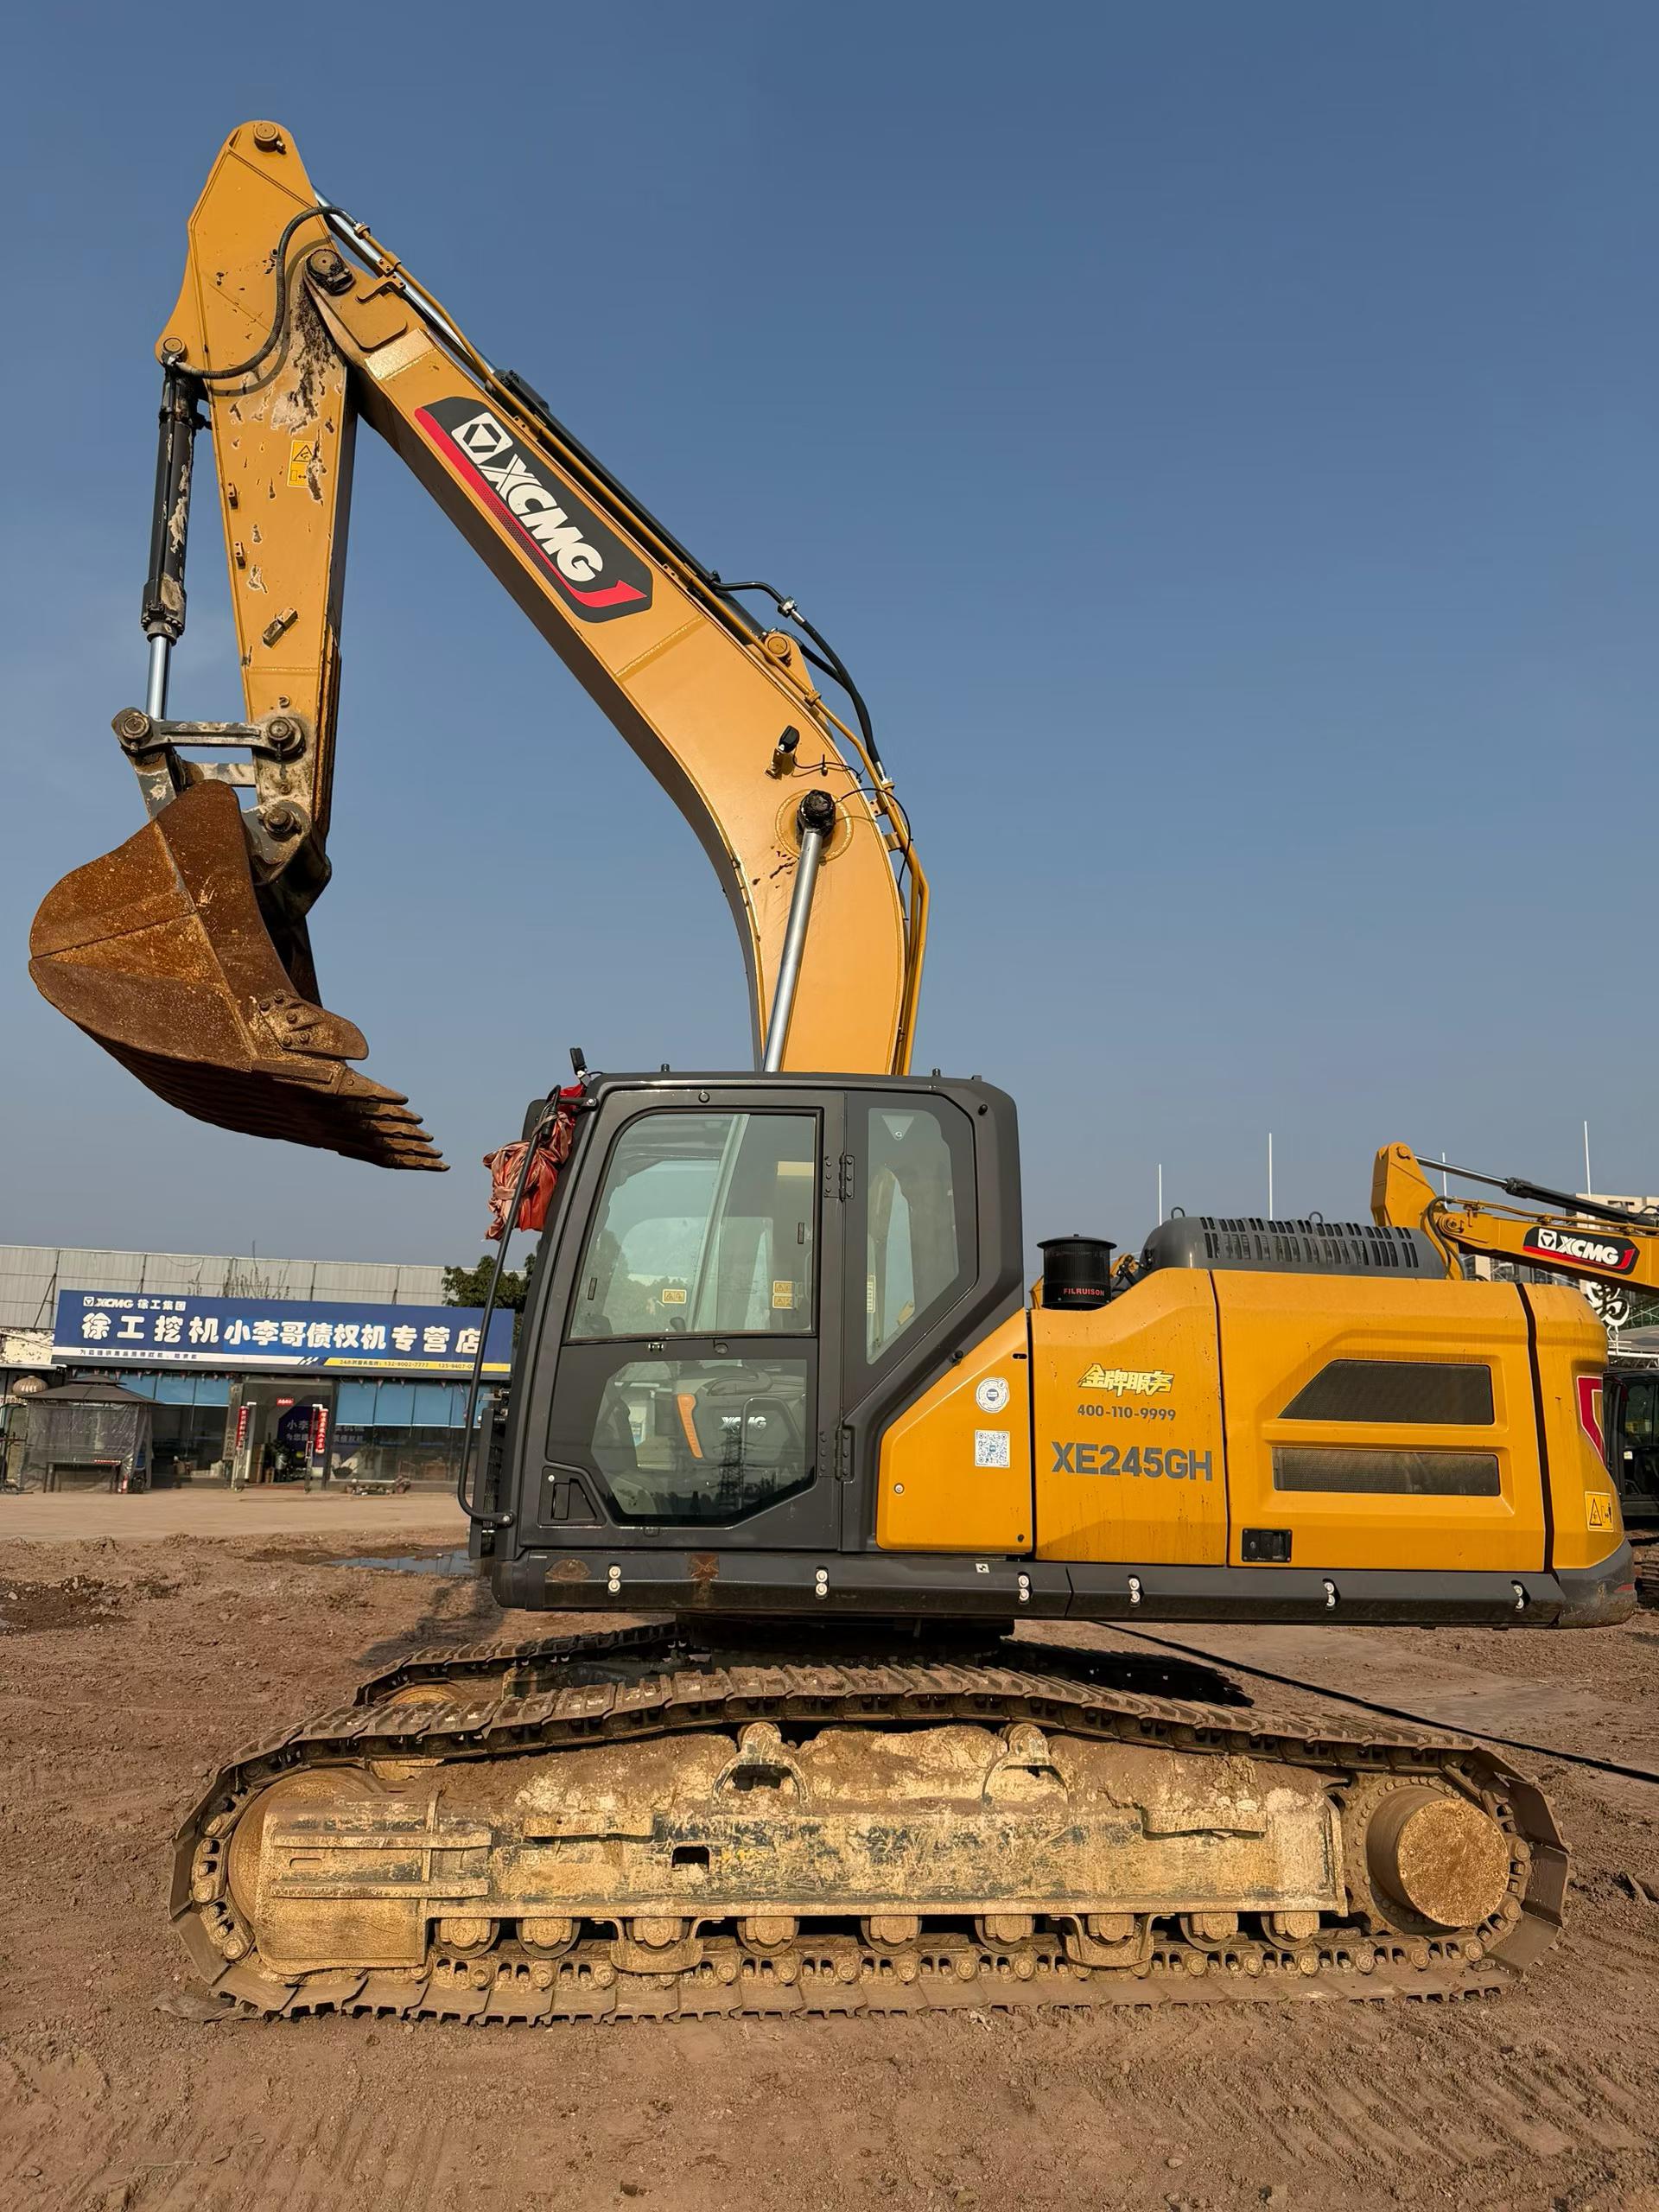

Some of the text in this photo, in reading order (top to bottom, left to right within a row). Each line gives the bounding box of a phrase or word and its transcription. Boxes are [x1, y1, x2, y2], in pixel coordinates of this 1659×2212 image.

[477, 454, 603, 582] XCMG
[1555, 1236, 1618, 1265] XCMG
[94, 1298, 187, 1312] XCMG 徐工集团
[1077, 1363, 1175, 1397] 金牌服务
[719, 1416, 767, 1433] XCG
[1077, 1403, 1176, 1421] 400-110-9999
[1051, 1440, 1213, 1482] XE245GH
